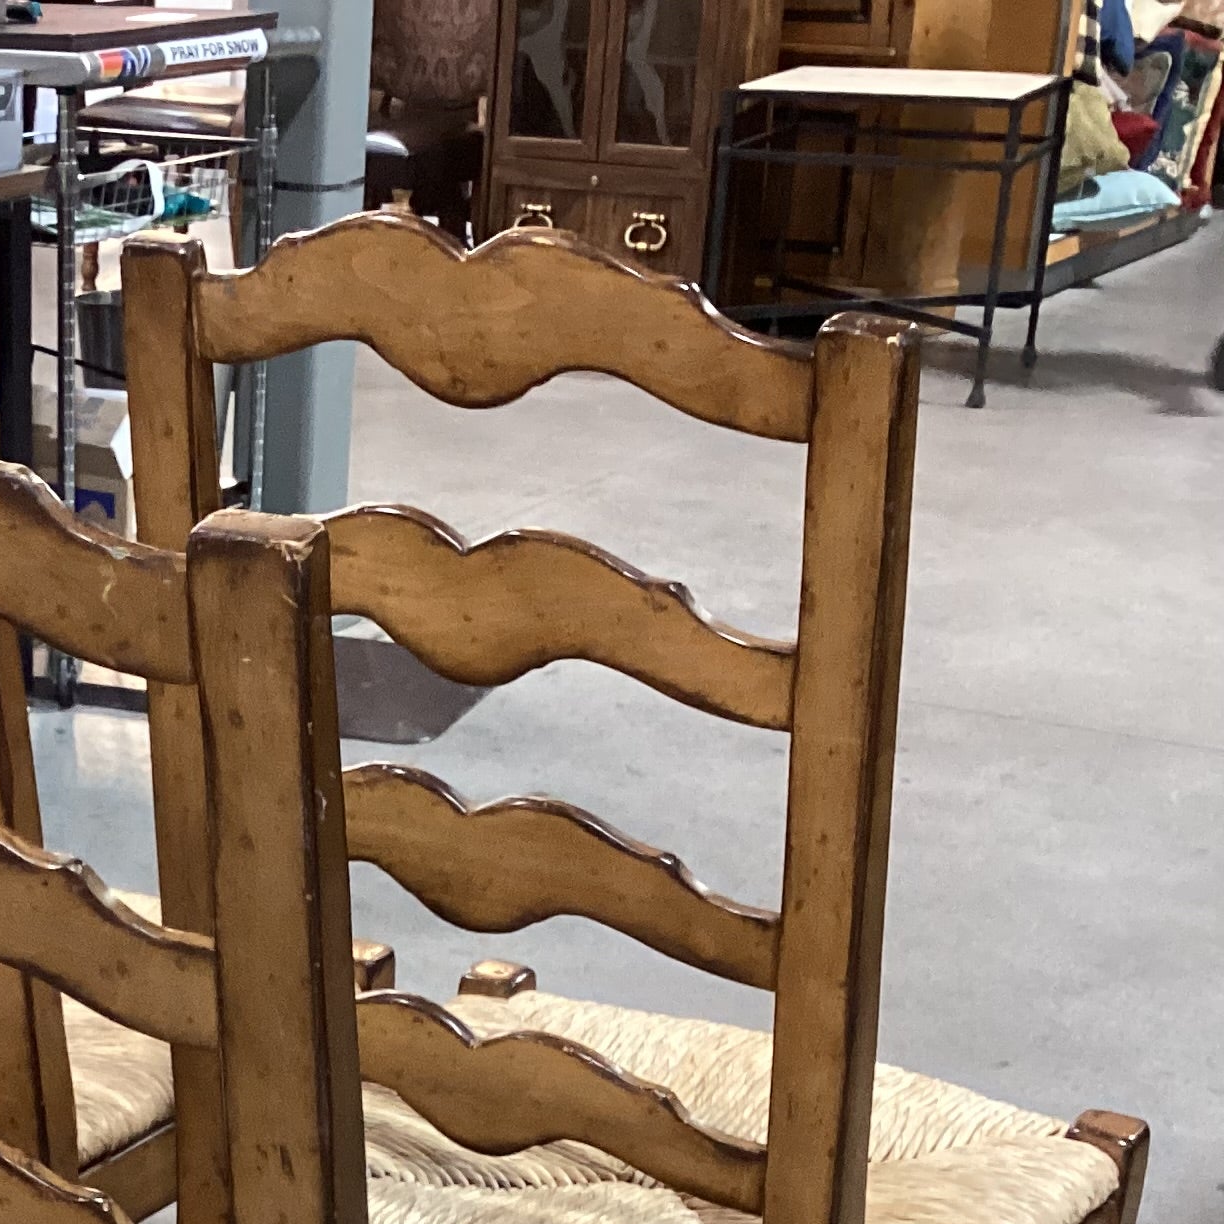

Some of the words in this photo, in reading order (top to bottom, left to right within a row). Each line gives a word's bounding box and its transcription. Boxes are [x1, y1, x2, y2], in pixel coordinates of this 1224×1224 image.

[170, 44, 199, 61] PRAY
[202, 41, 225, 57] FOR
[226, 38, 259, 55] SNOW
